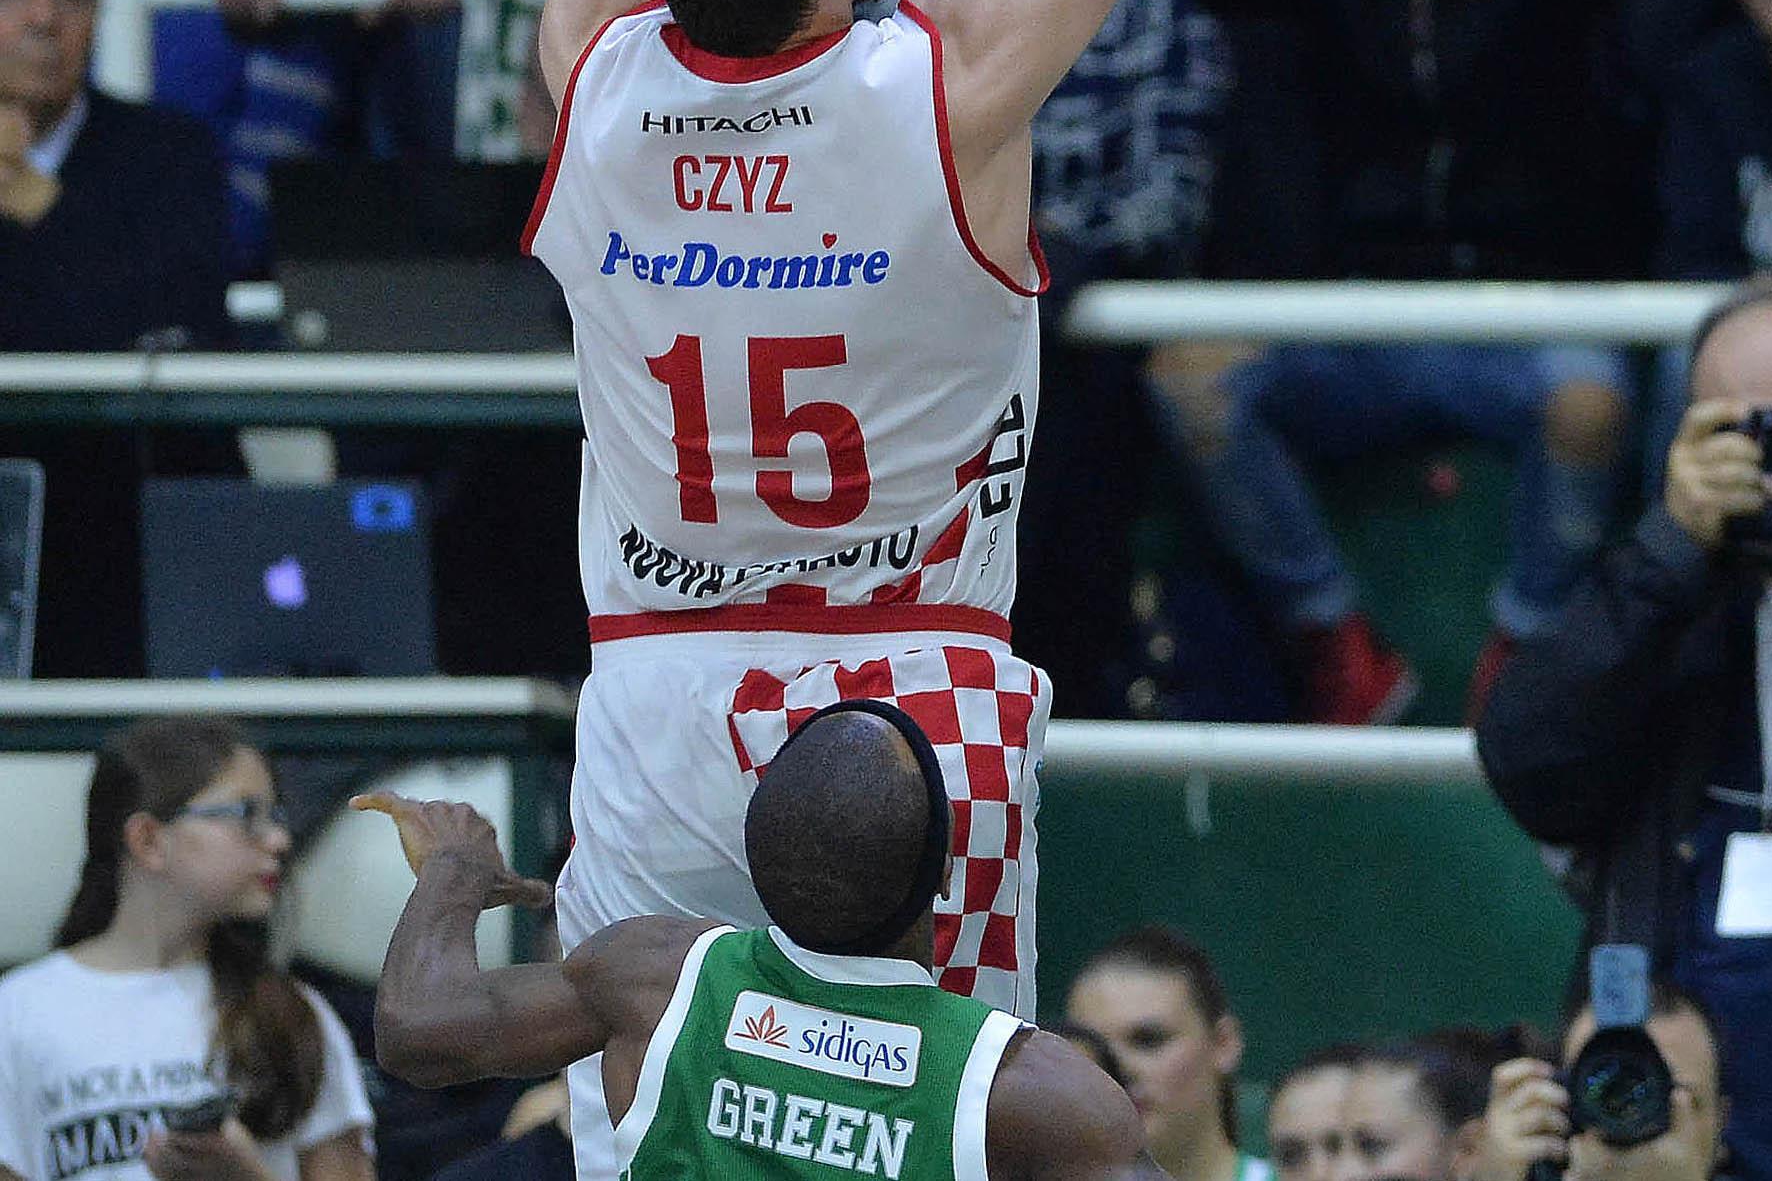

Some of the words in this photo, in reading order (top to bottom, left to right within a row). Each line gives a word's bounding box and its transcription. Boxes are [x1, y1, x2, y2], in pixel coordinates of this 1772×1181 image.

[641, 106, 814, 135] HITACHI
[673, 155, 793, 213] CZYZ
[600, 231, 890, 290] PerDormire
[644, 334, 871, 528] 15
[707, 1078, 915, 1180] GREEN
